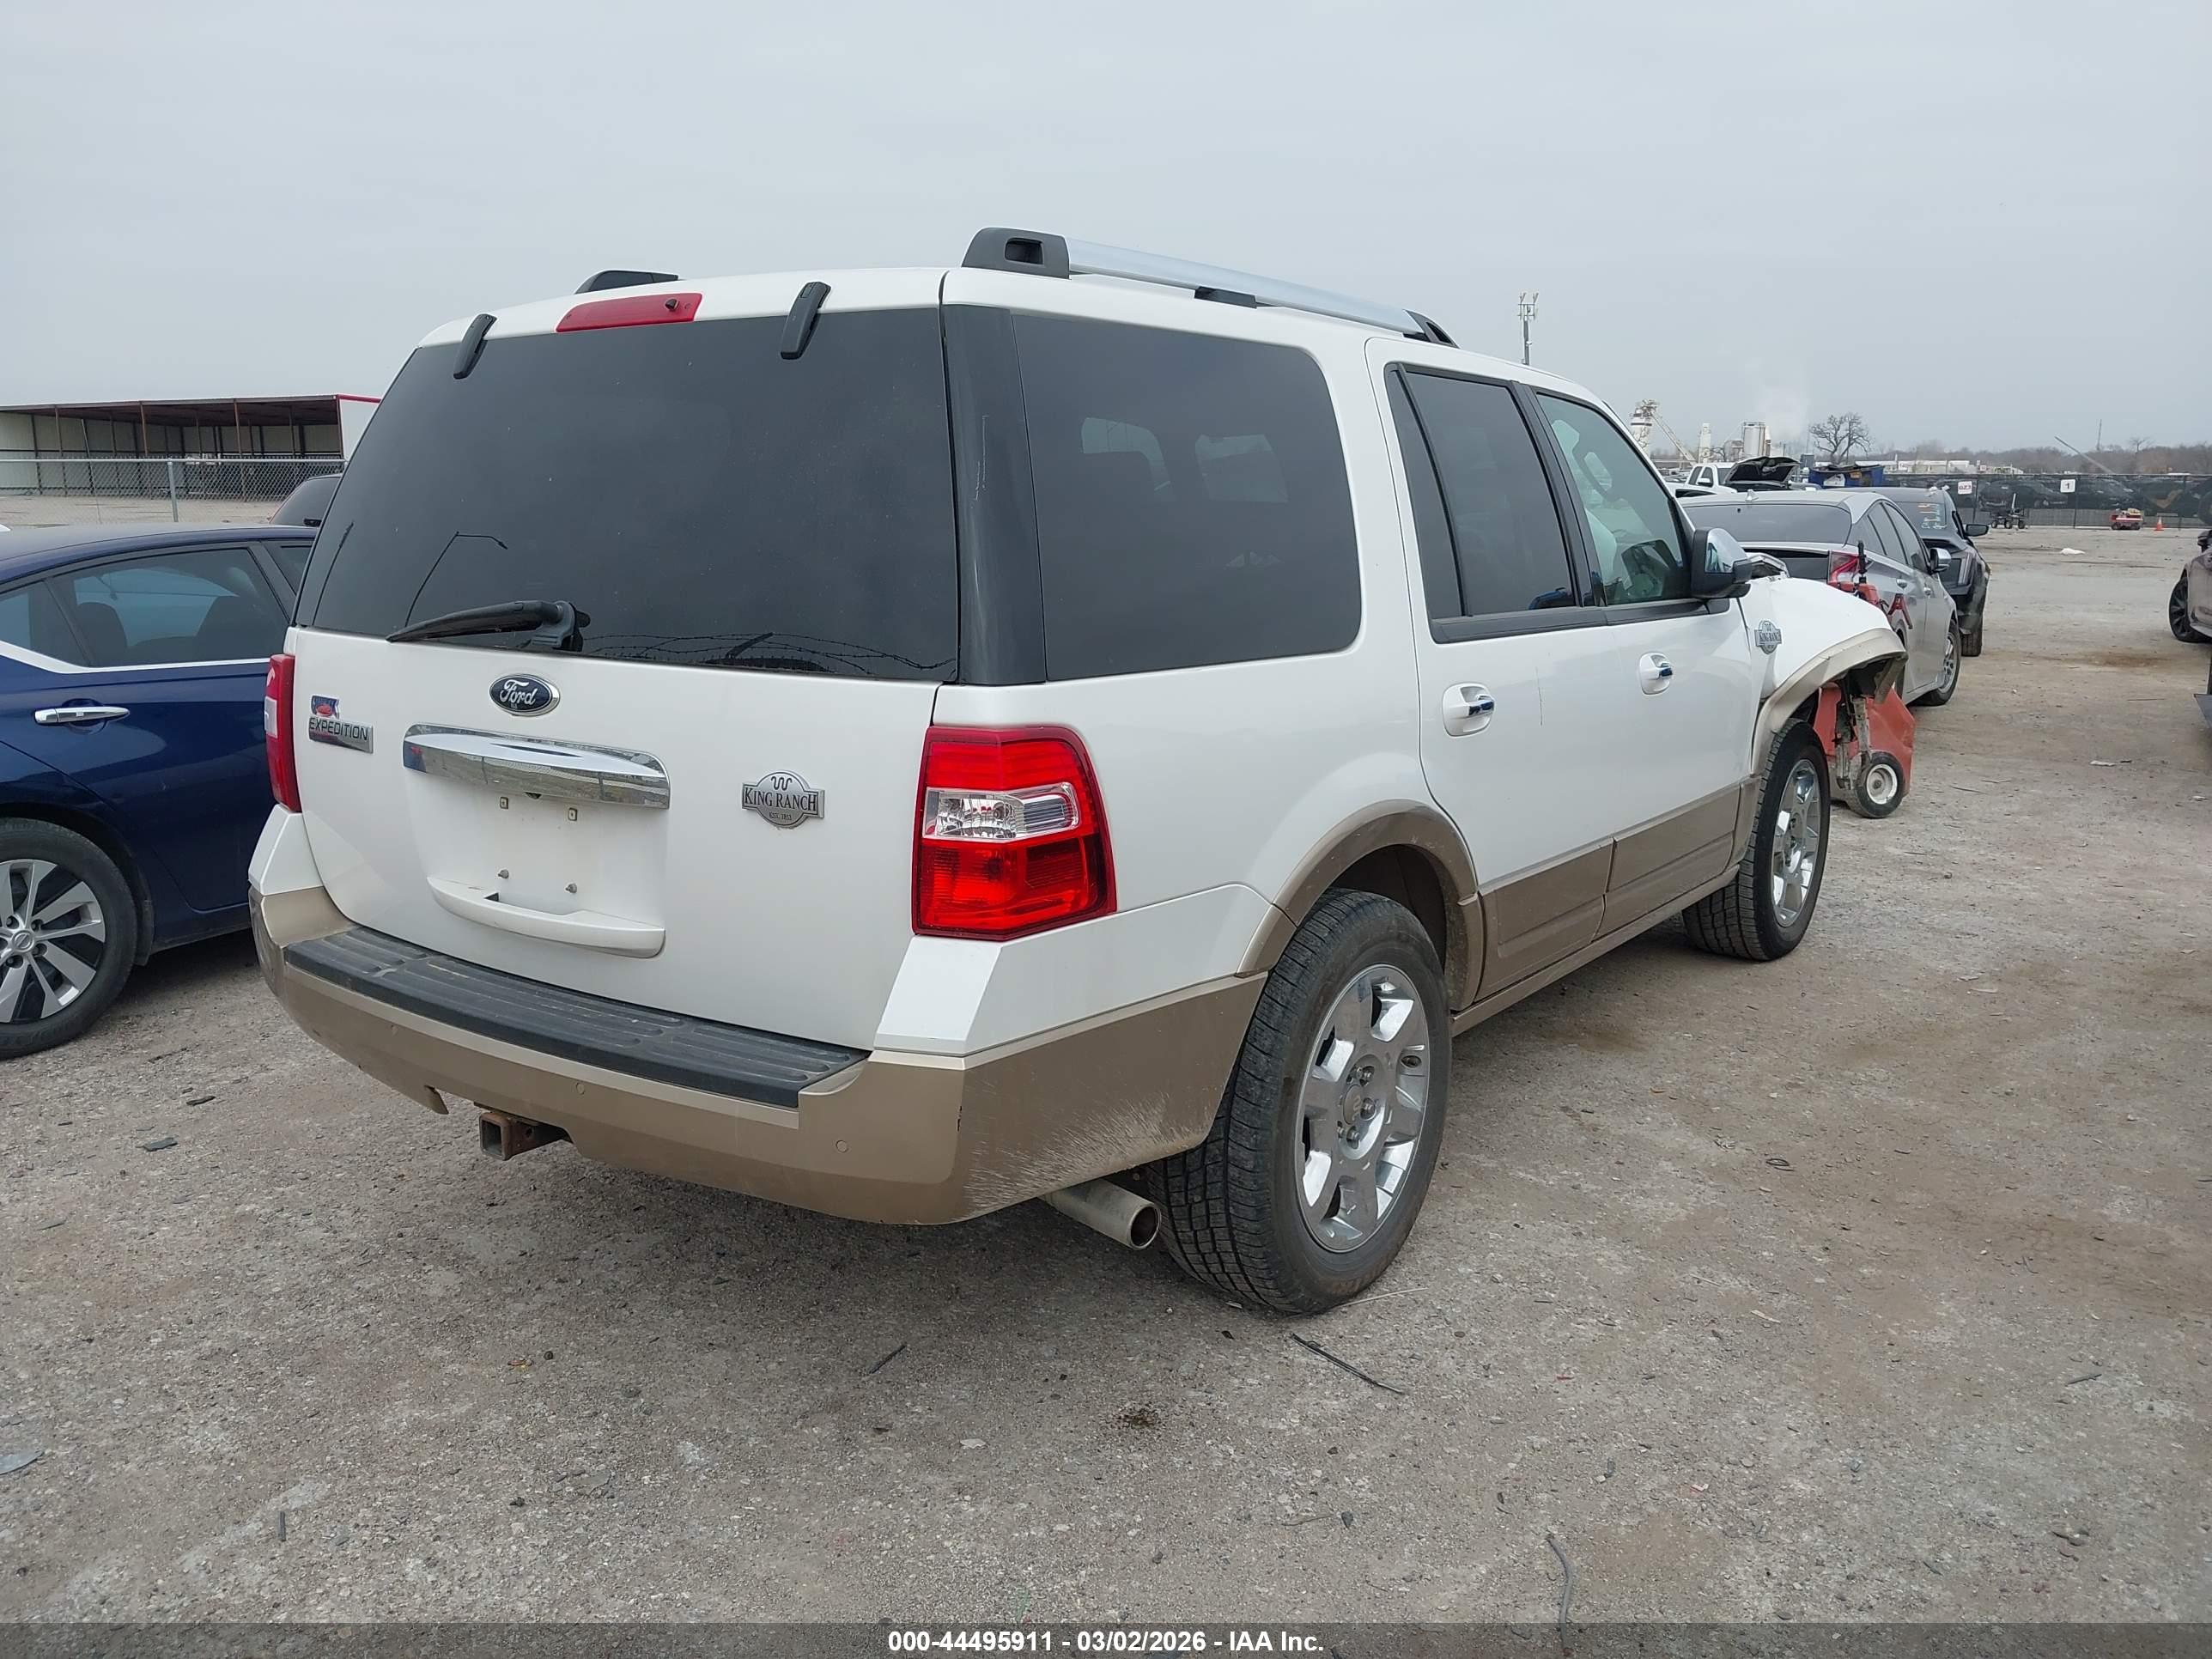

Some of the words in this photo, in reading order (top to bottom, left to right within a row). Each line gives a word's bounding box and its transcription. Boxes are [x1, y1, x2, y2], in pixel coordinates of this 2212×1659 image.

[500, 679, 538, 705] Ford
[309, 718, 368, 740] EXPEDITION
[744, 787, 773, 807] KING
[775, 793, 817, 811] RANCH
